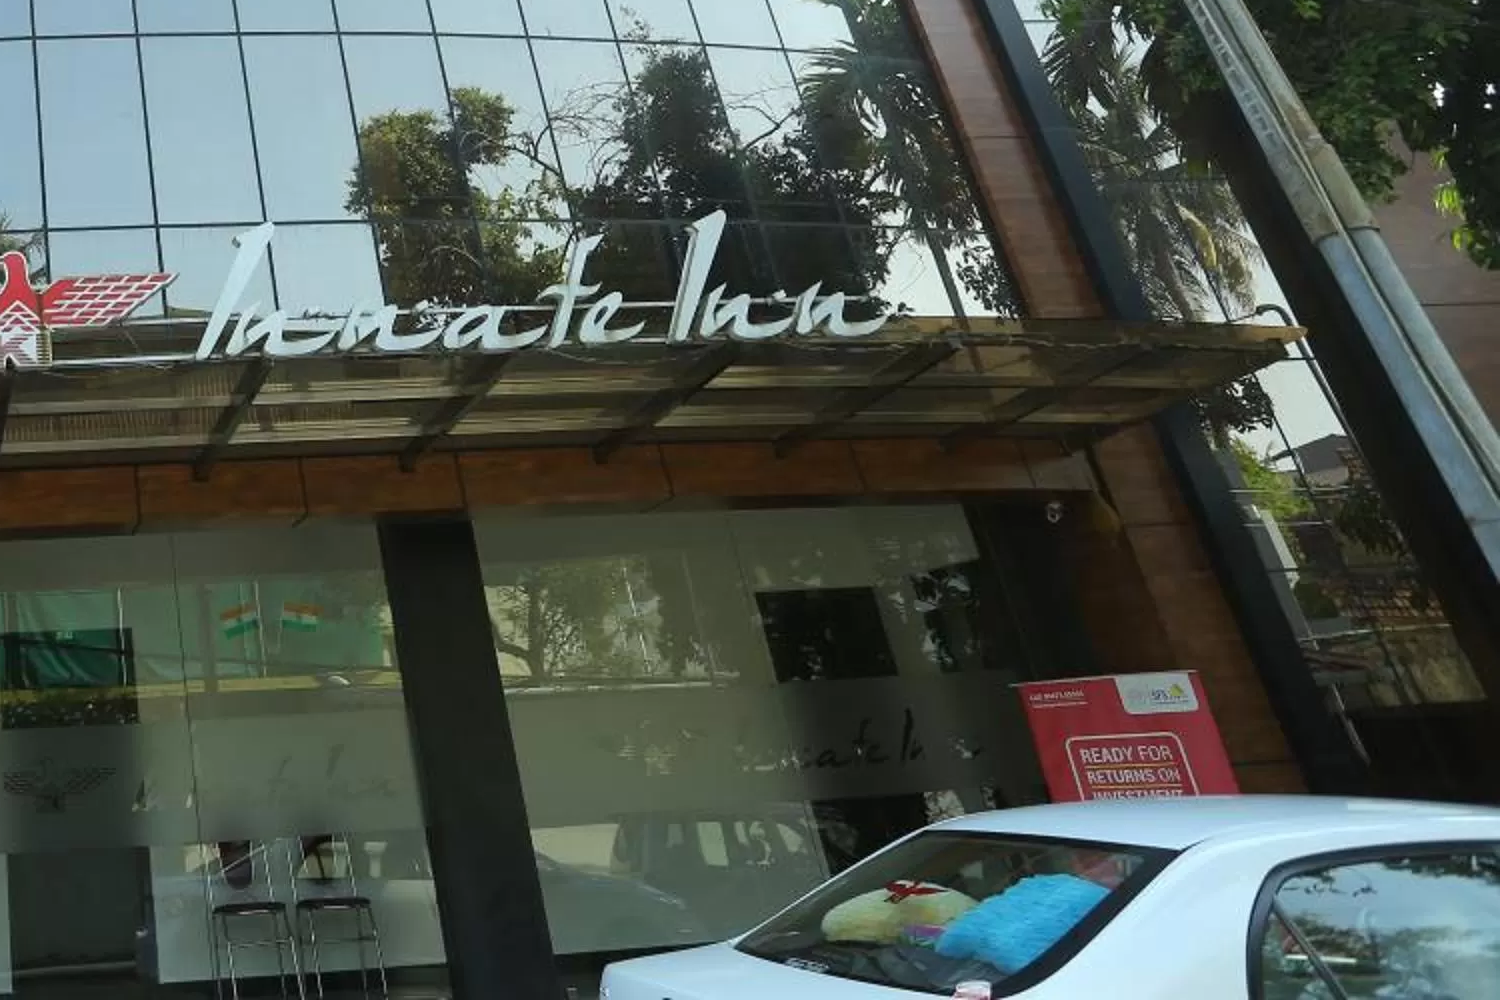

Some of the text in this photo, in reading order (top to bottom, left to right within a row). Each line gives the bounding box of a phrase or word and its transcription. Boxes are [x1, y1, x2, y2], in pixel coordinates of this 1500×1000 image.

[196, 209, 888, 360] Innate Inn
[1080, 744, 1173, 764] READY FOR
[1087, 766, 1182, 785] RETURNS ON
